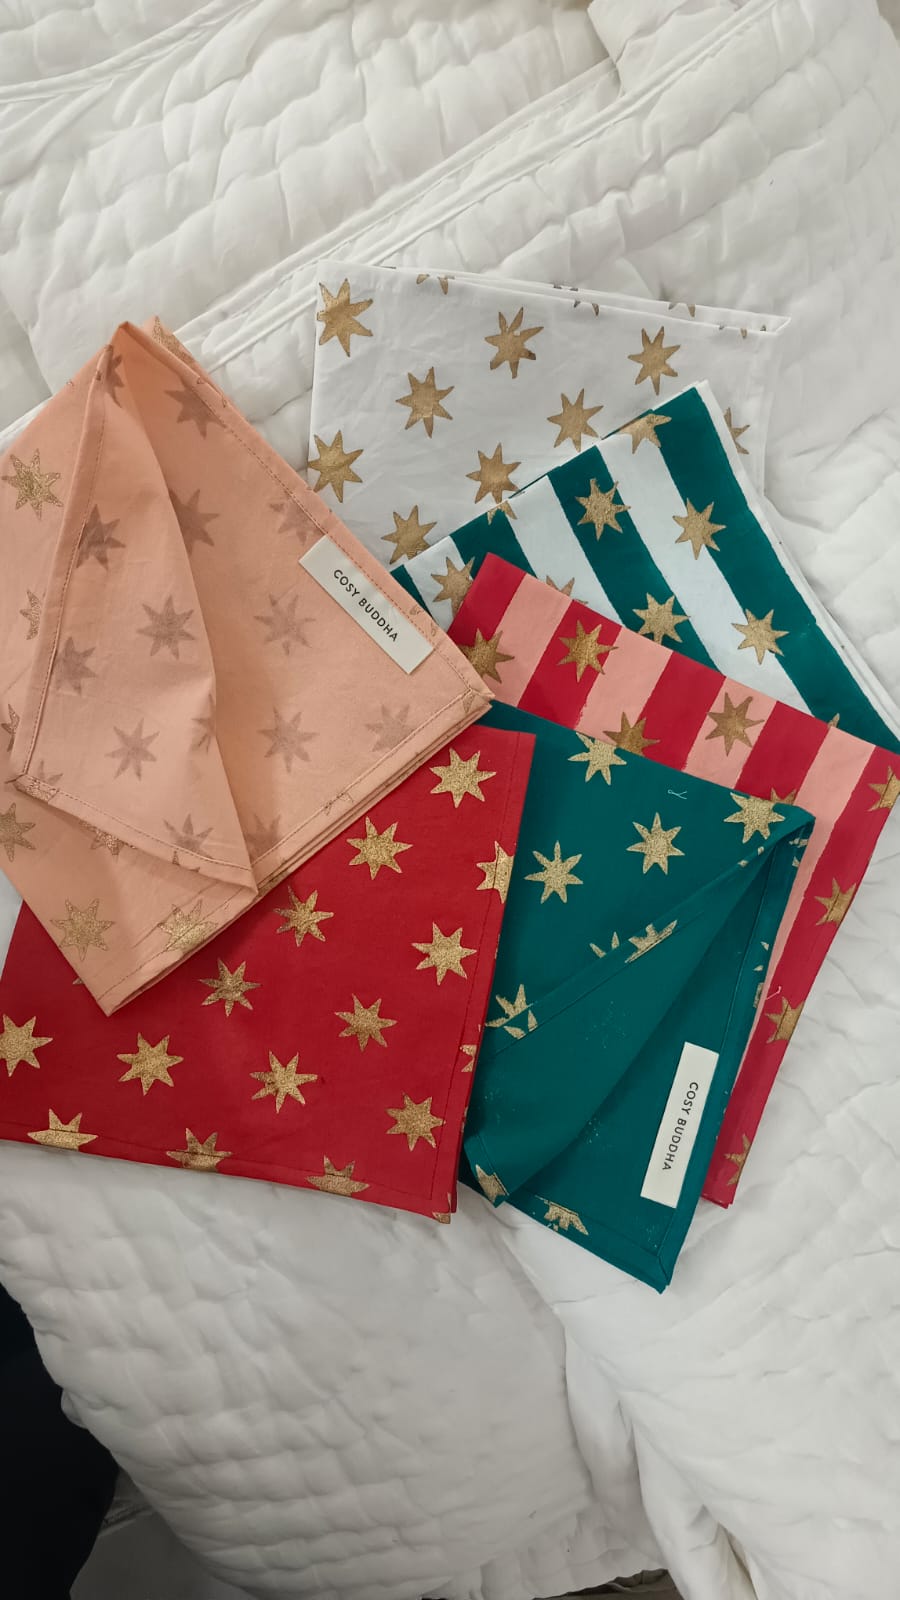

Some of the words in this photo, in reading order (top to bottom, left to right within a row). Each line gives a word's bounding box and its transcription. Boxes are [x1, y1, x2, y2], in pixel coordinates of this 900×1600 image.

[333, 569, 360, 597] COSY
[358, 597, 398, 642] BUDDHA
[681, 1082, 699, 1115] COSY
[662, 1118, 687, 1170] BUDDHA
